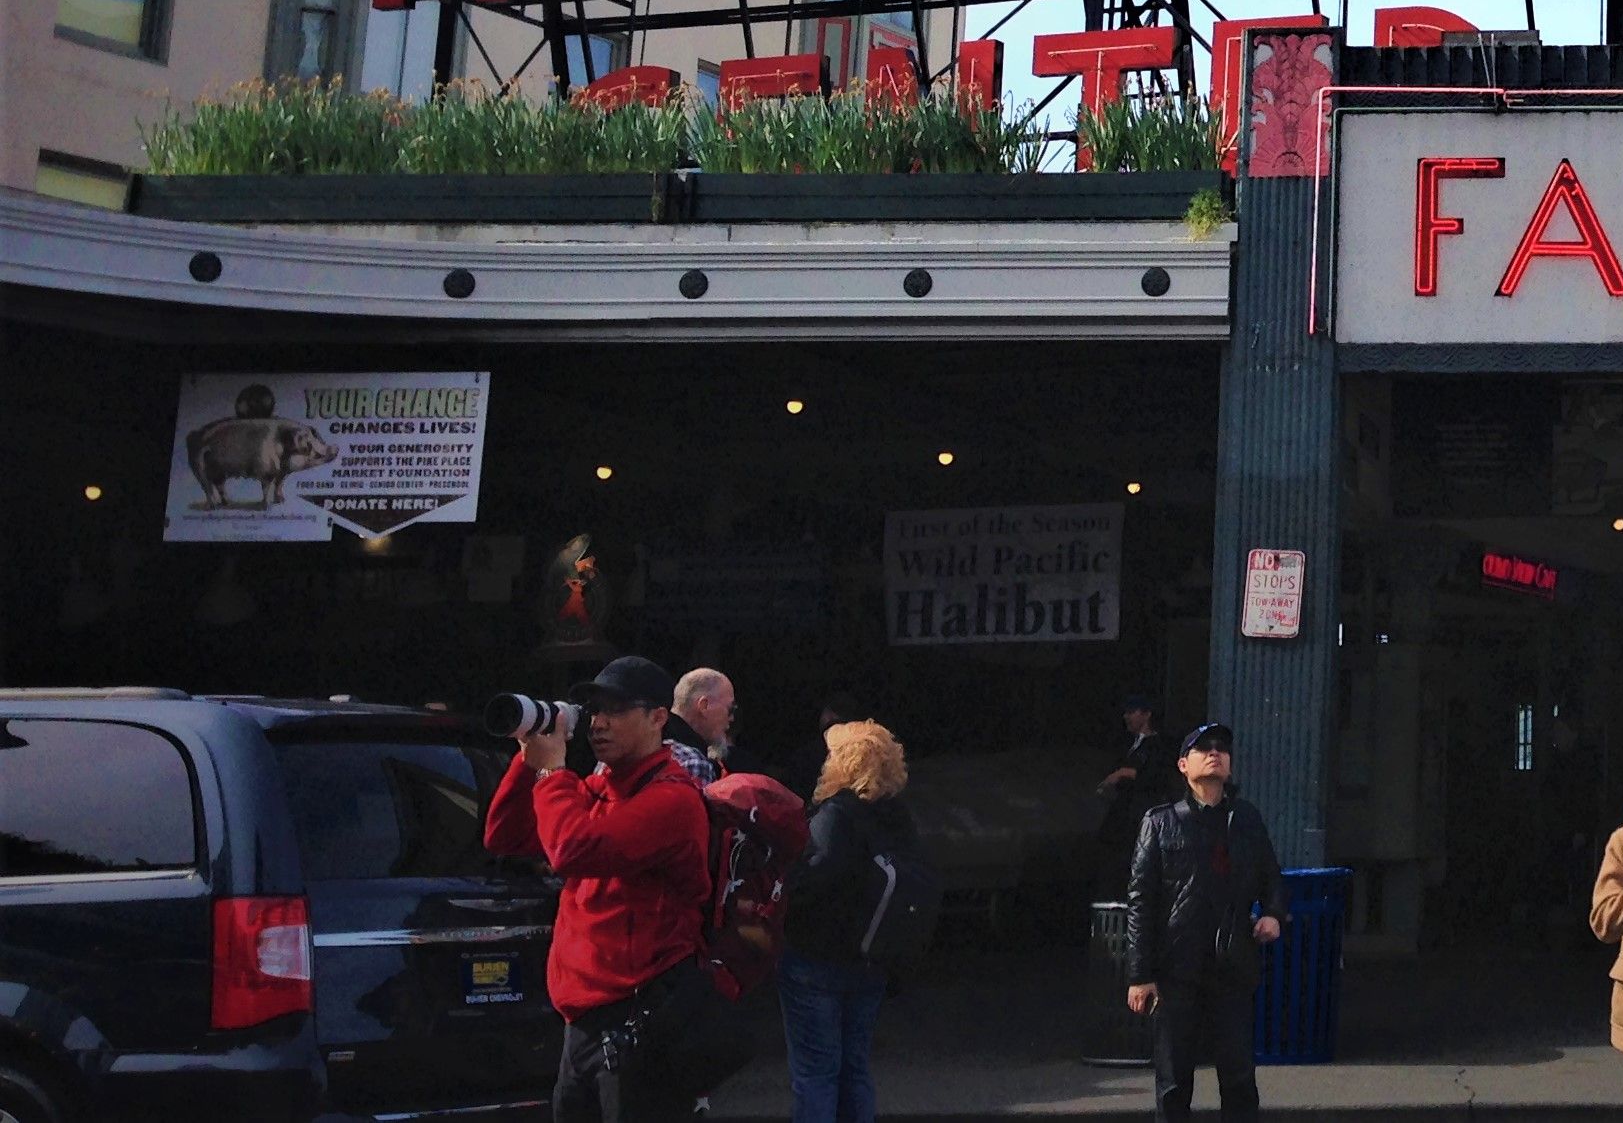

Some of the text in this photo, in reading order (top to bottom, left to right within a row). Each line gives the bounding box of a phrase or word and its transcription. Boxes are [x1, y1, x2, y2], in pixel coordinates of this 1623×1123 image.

[304, 387, 480, 419] YOUR CHANGE
[329, 421, 476, 434] CHANGES LIVES!
[350, 444, 474, 454] YOUR GENEROSITY
[341, 456, 472, 467] SUPPORTS THE PIKE PLACE
[332, 469, 470, 478] MARKET FOUNDATION
[324, 498, 439, 510] DONATE HERE!
[959, 513, 979, 536] of
[989, 513, 1022, 534] the
[1032, 514, 1111, 534] Season
[899, 540, 1111, 576] Wild Pacific
[1253, 552, 1275, 569] NO
[1254, 575, 1296, 589] STOPS
[894, 582, 1107, 638] Halibut
